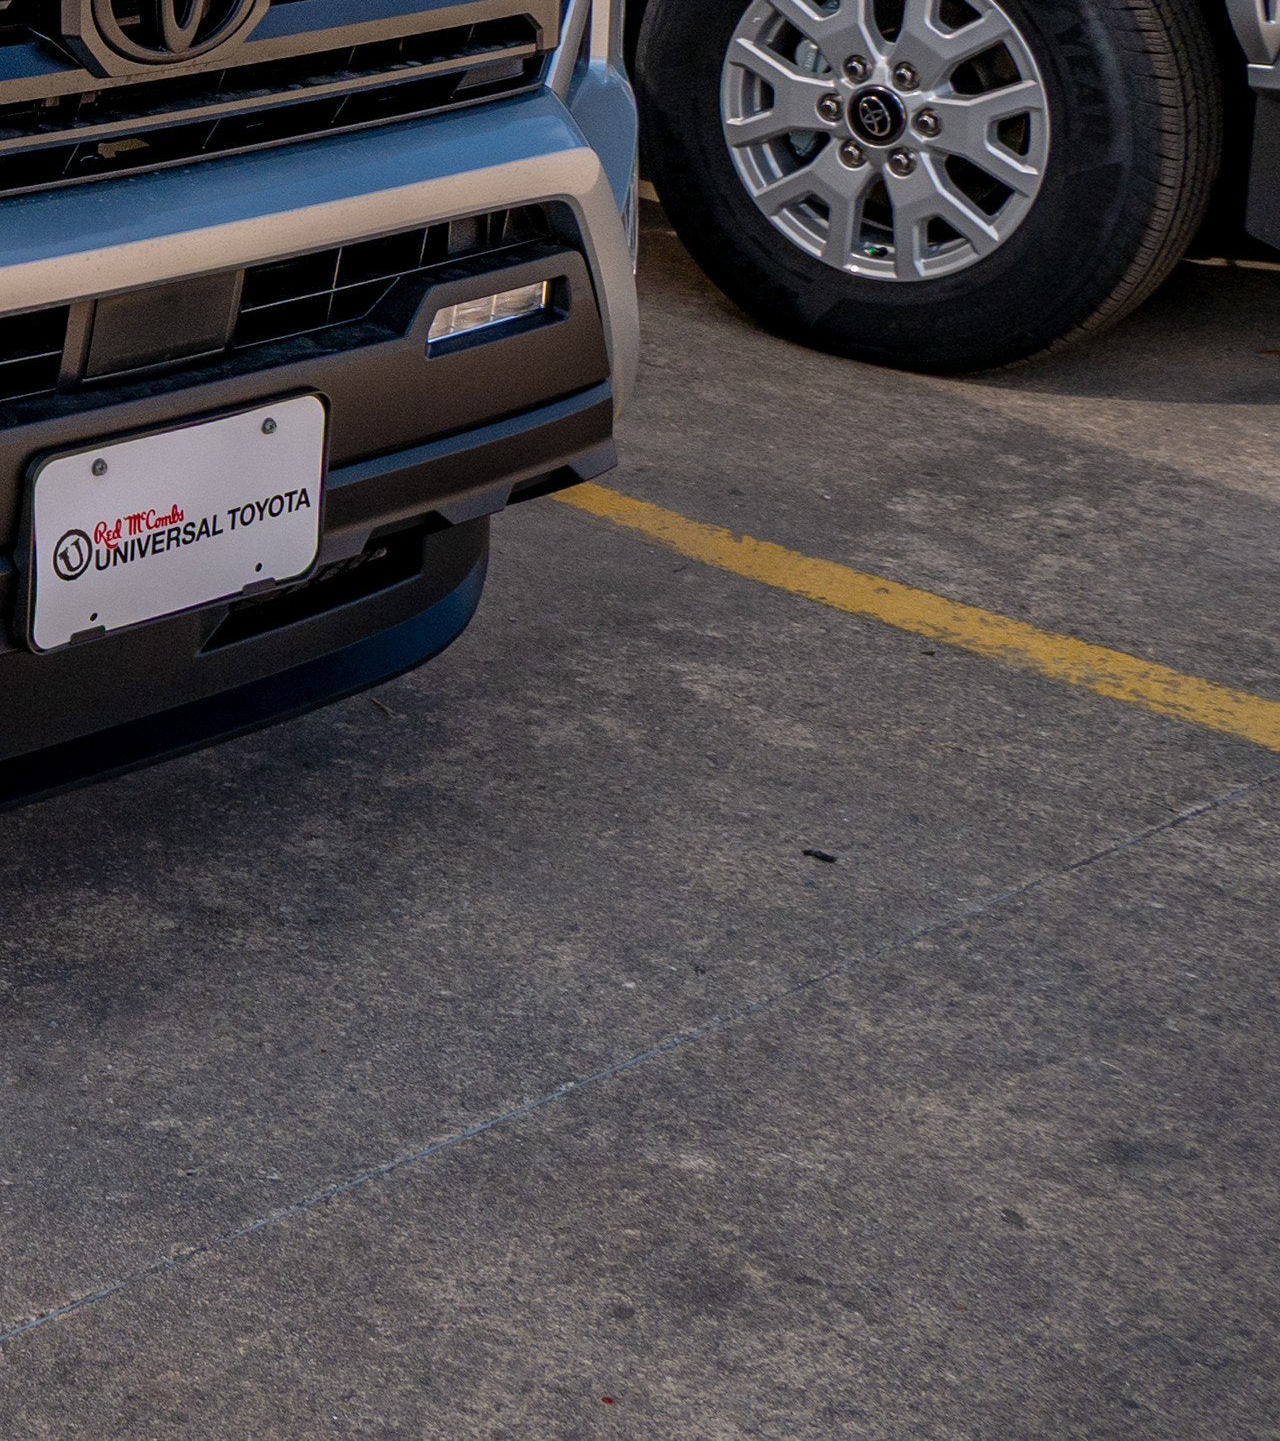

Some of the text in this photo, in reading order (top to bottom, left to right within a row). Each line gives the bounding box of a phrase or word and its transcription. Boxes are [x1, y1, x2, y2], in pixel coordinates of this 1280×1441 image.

[94, 519, 122, 550] Red
[95, 487, 311, 571] UNIVERSAL TOYOTA
